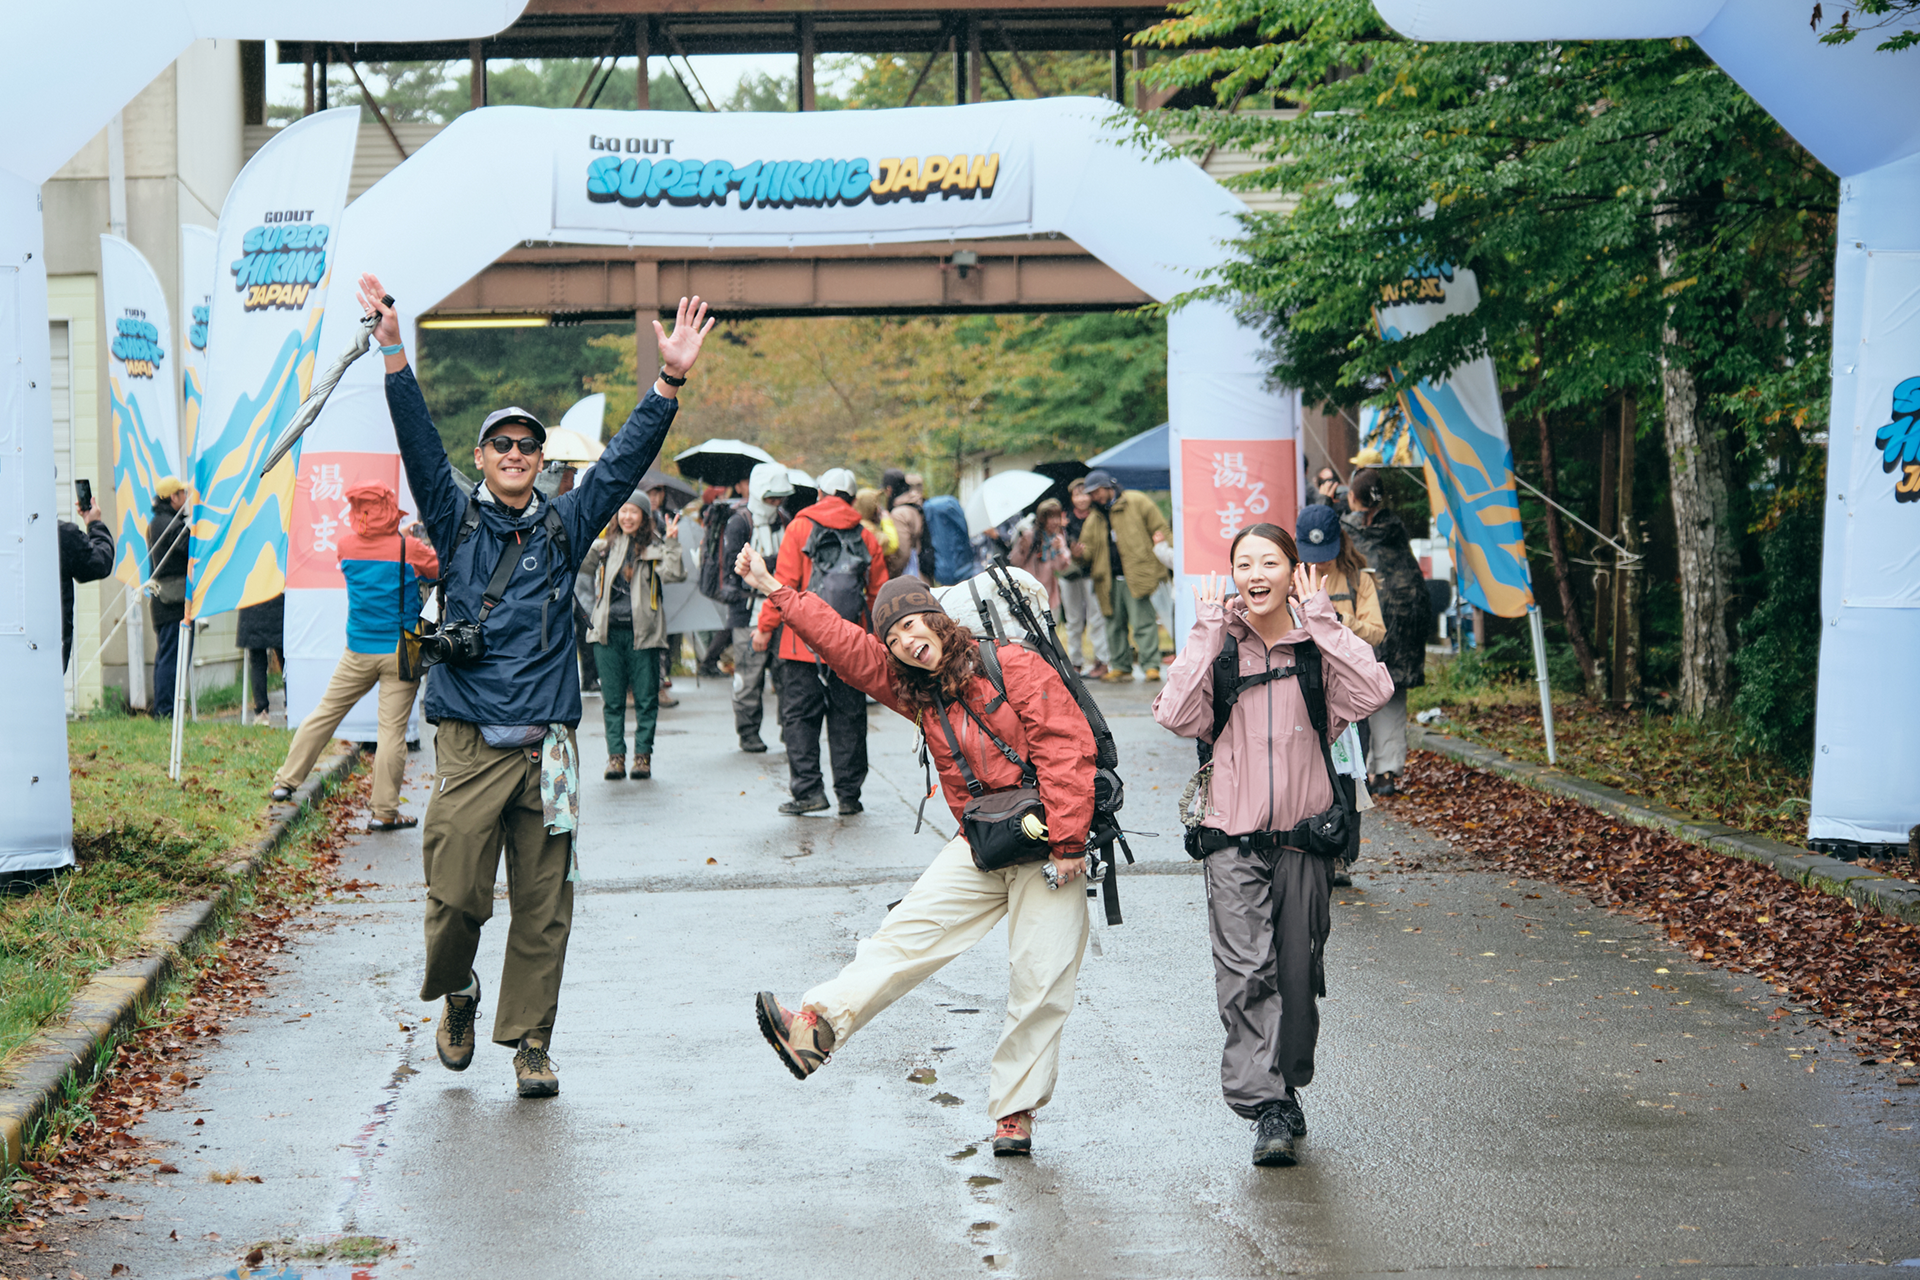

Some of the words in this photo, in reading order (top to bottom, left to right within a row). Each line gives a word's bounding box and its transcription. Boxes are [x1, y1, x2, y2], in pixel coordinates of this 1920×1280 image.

[589, 134, 621, 153] GO
[624, 137, 675, 155] OUT
[587, 156, 734, 207] SUPER
[728, 158, 872, 209] HIKING
[870, 153, 998, 205] JAPAN
[243, 223, 329, 258] SUPER
[230, 250, 326, 293] HIKING
[244, 283, 310, 313] JAPAN
